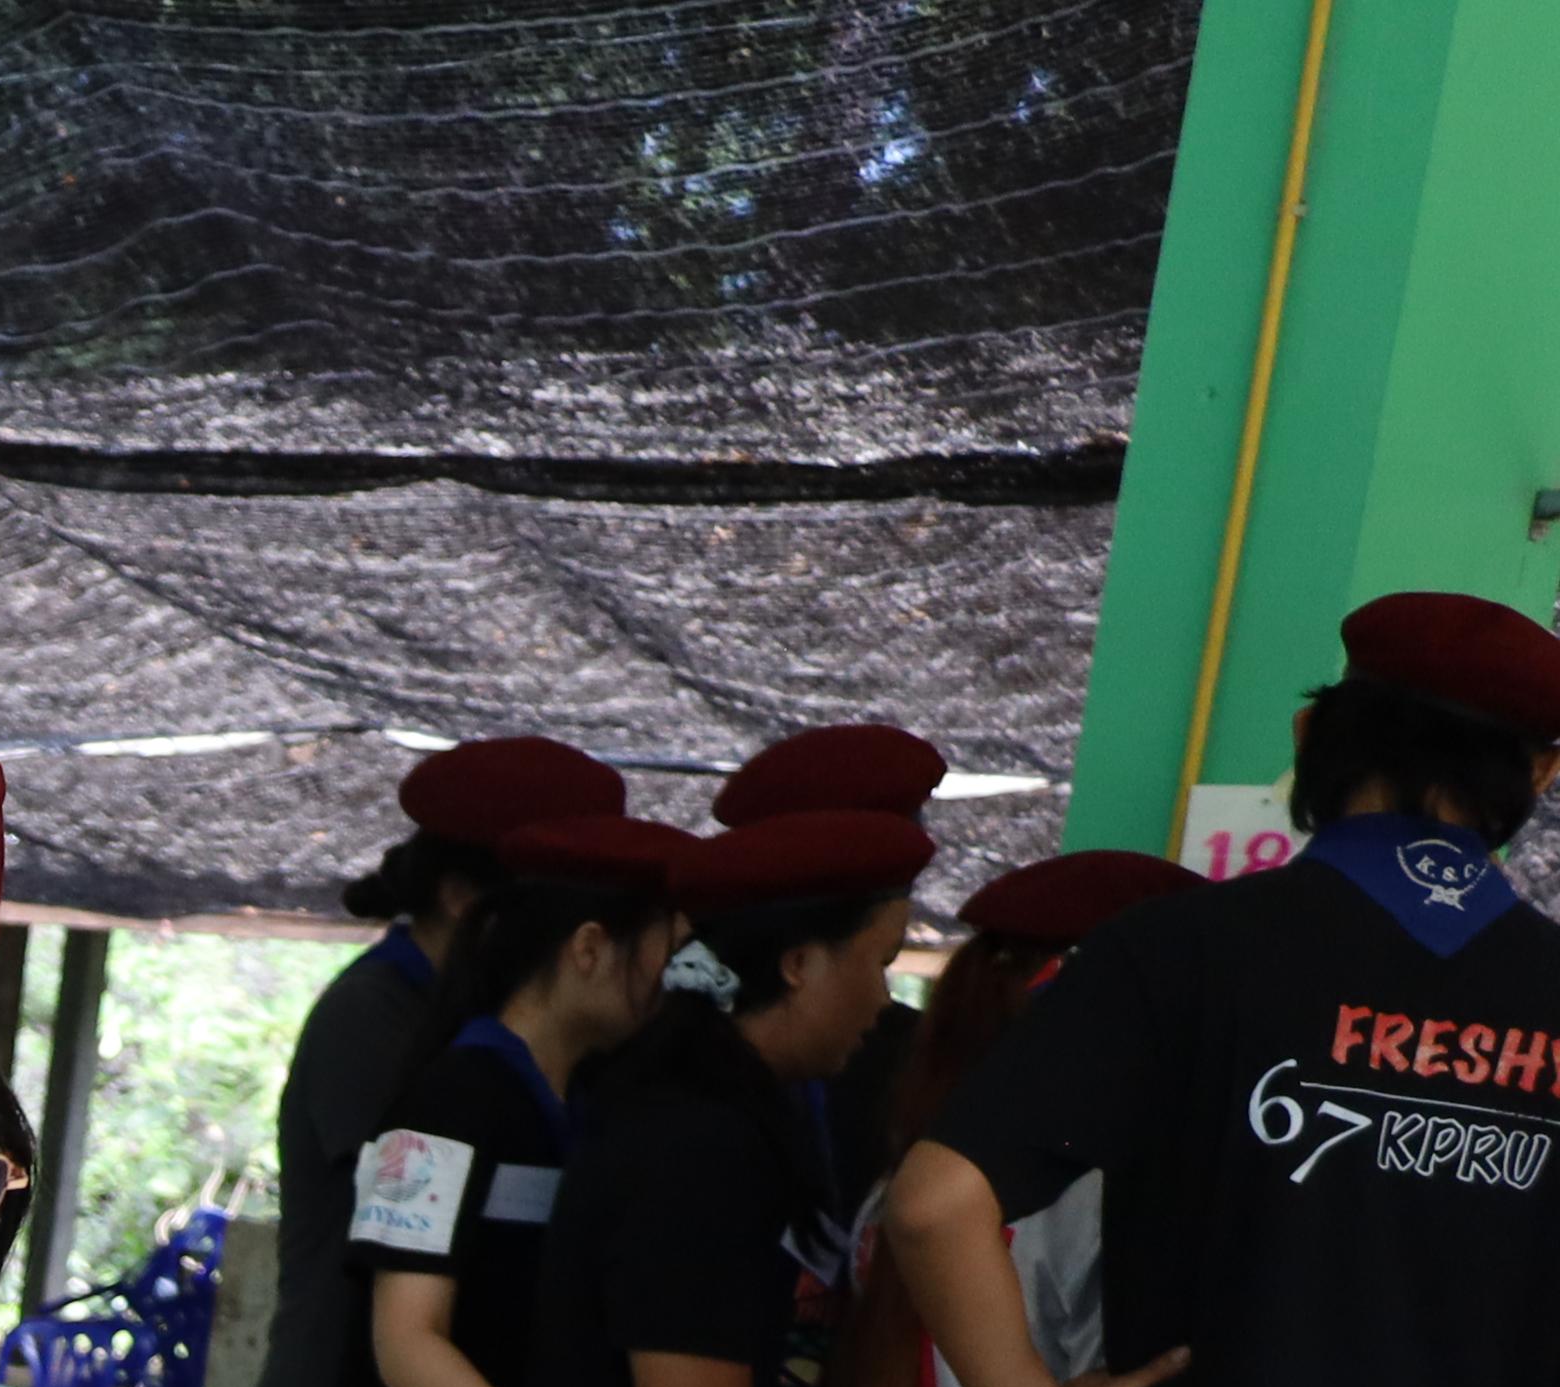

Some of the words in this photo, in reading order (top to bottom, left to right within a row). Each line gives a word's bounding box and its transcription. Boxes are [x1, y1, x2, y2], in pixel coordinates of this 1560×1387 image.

[1330, 1002, 1560, 1100] FRESH
[1247, 1057, 1373, 1185] 67
[1377, 1109, 1552, 1193] KPRU
